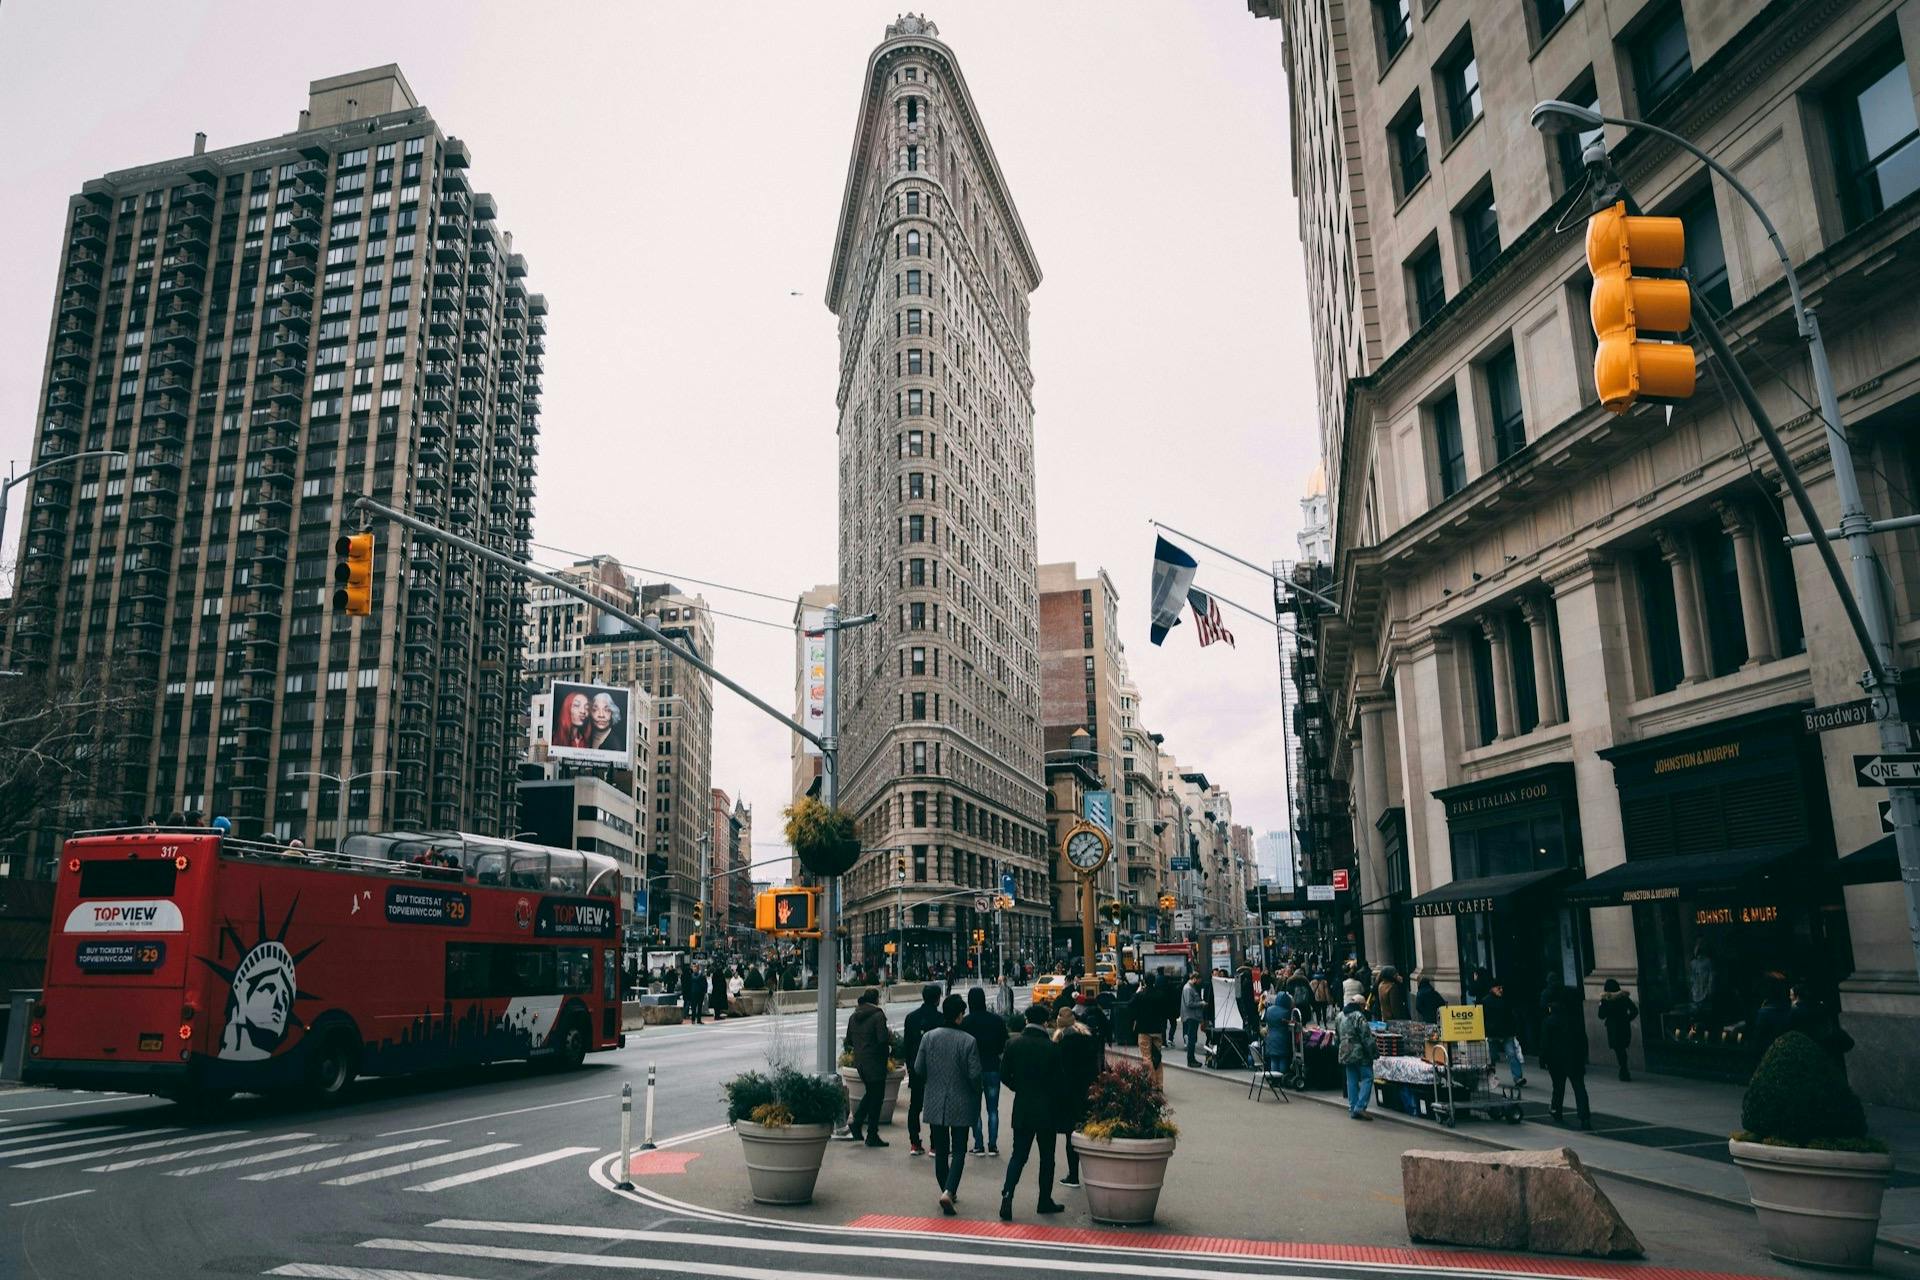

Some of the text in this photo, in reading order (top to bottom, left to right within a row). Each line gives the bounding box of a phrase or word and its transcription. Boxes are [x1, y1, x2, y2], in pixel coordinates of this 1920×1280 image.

[1805, 705, 1867, 730] Broadway
[1654, 752, 1696, 774] JOHNSTON
[1703, 742, 1740, 763] MURPHY
[1871, 764, 1900, 777] ONE
[1453, 784, 1547, 814] FINE ITALIAN FOOD
[161, 846, 178, 858] 317
[395, 894, 408, 903] BUY
[409, 895, 433, 905] TICKETS
[433, 898, 443, 906] AT
[1415, 898, 1494, 916] EATALY CAFFE
[1451, 1010, 1474, 1020] Lego
